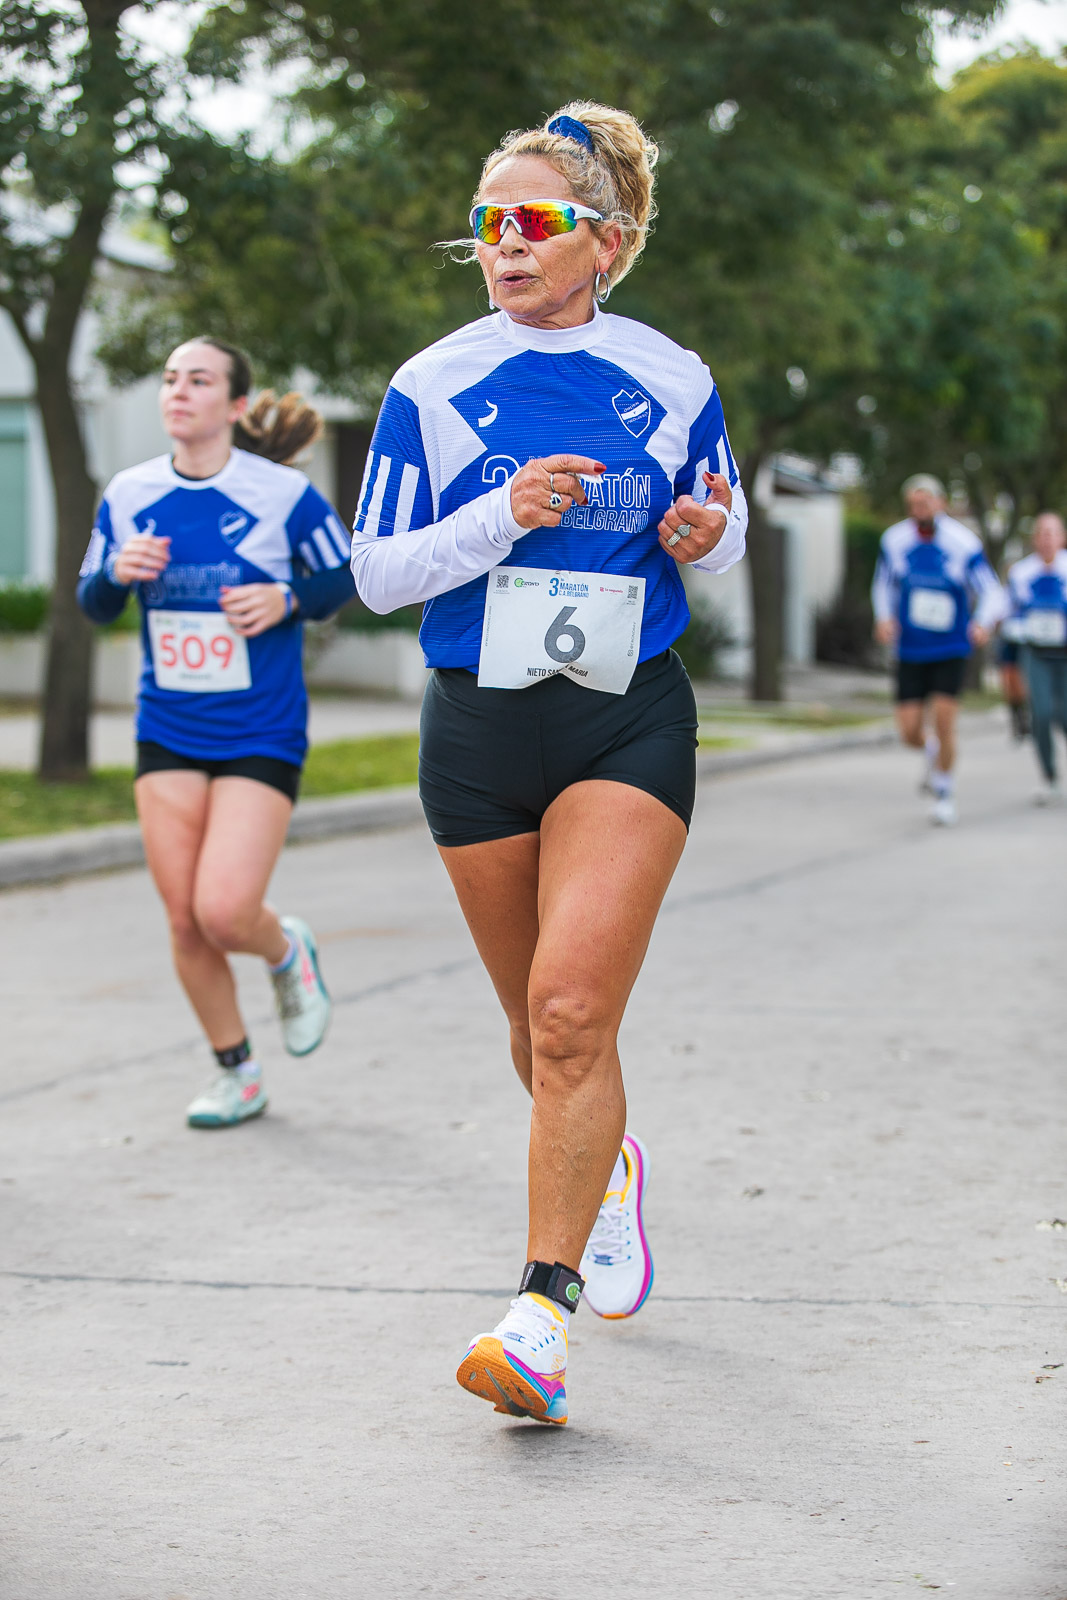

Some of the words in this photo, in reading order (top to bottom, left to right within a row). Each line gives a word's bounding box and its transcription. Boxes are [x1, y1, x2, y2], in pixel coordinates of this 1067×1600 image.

[549, 577, 559, 597] 3
[560, 582, 589, 592] MARATÓN
[544, 605, 586, 664] 6
[159, 633, 235, 670] 509
[526, 667, 547, 677] NIETO
